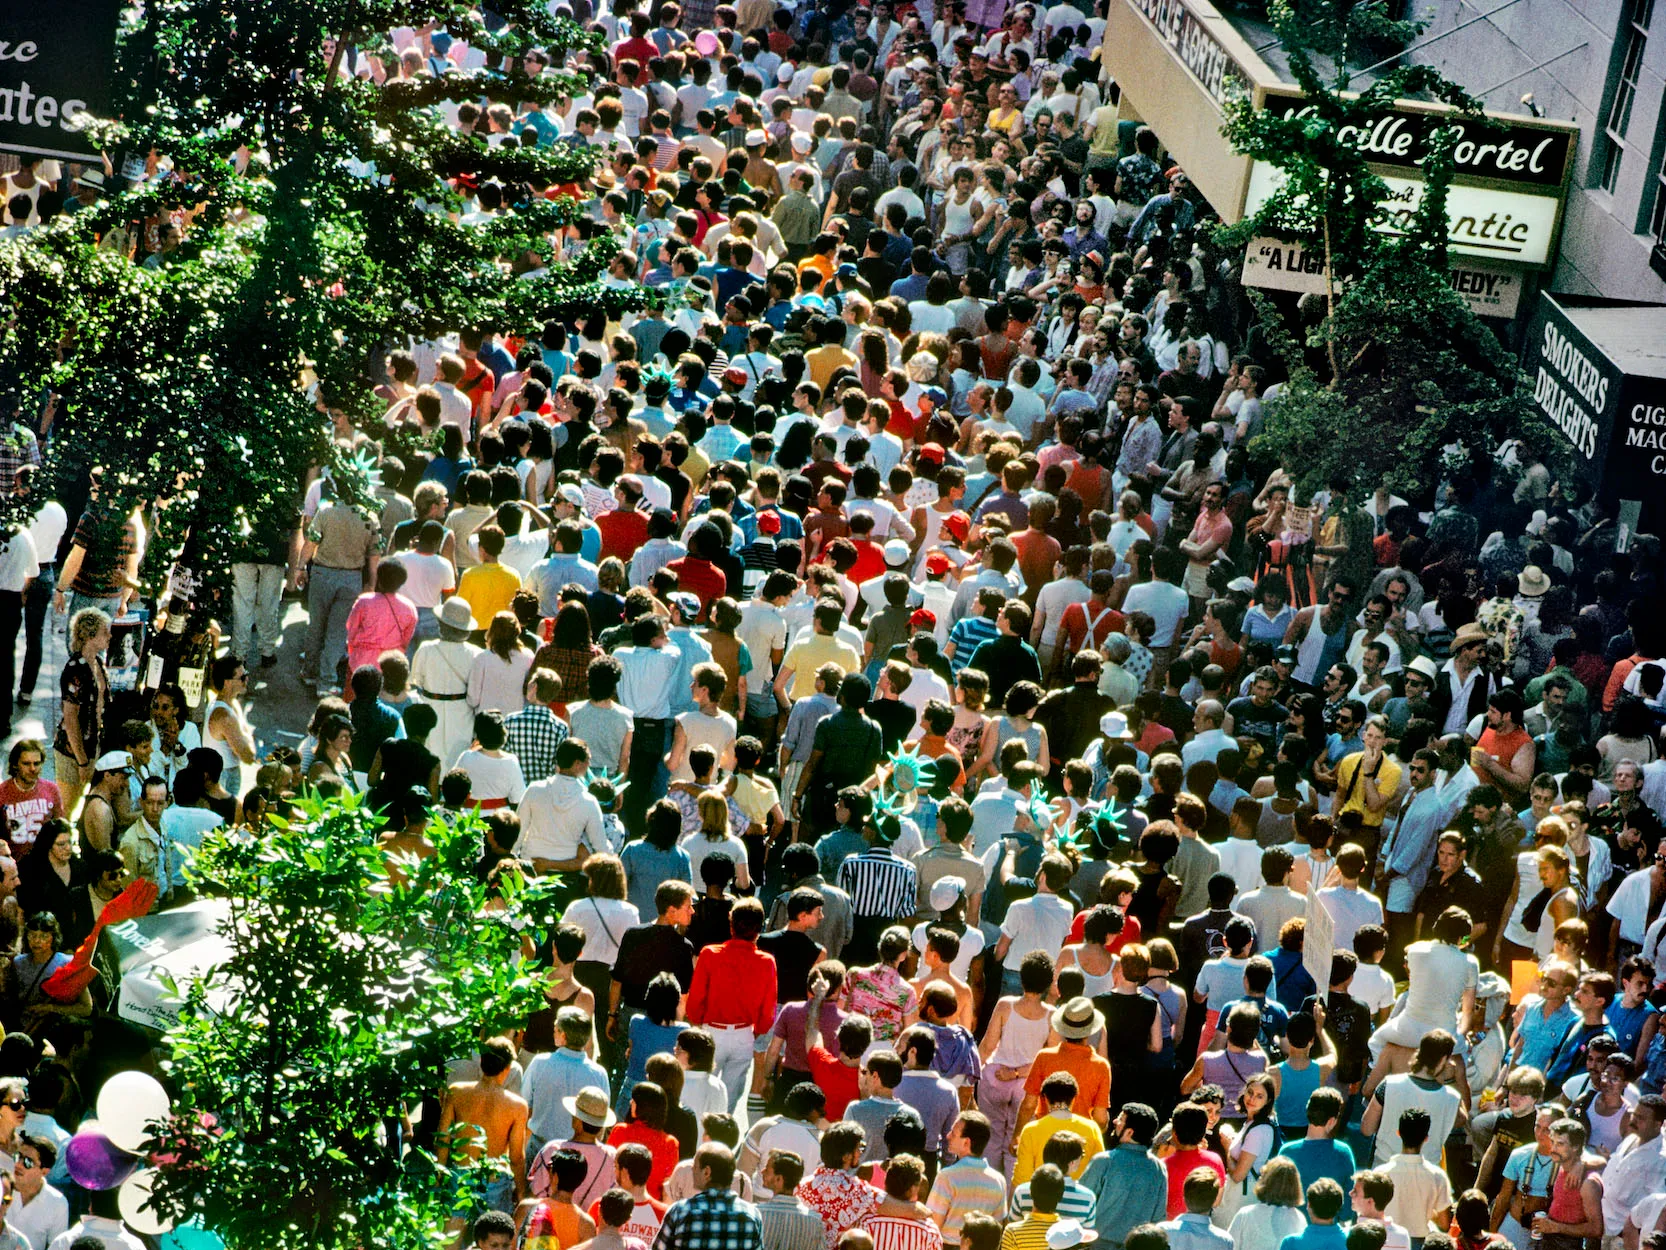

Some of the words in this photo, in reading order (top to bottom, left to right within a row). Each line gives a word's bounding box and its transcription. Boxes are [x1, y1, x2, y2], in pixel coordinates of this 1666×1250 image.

[1182, 16, 1228, 104] LORTEL
[1541, 321, 1609, 414] SMOKERS
[1533, 366, 1599, 460] DELIGHTS
[1631, 404, 1666, 427] CIG
